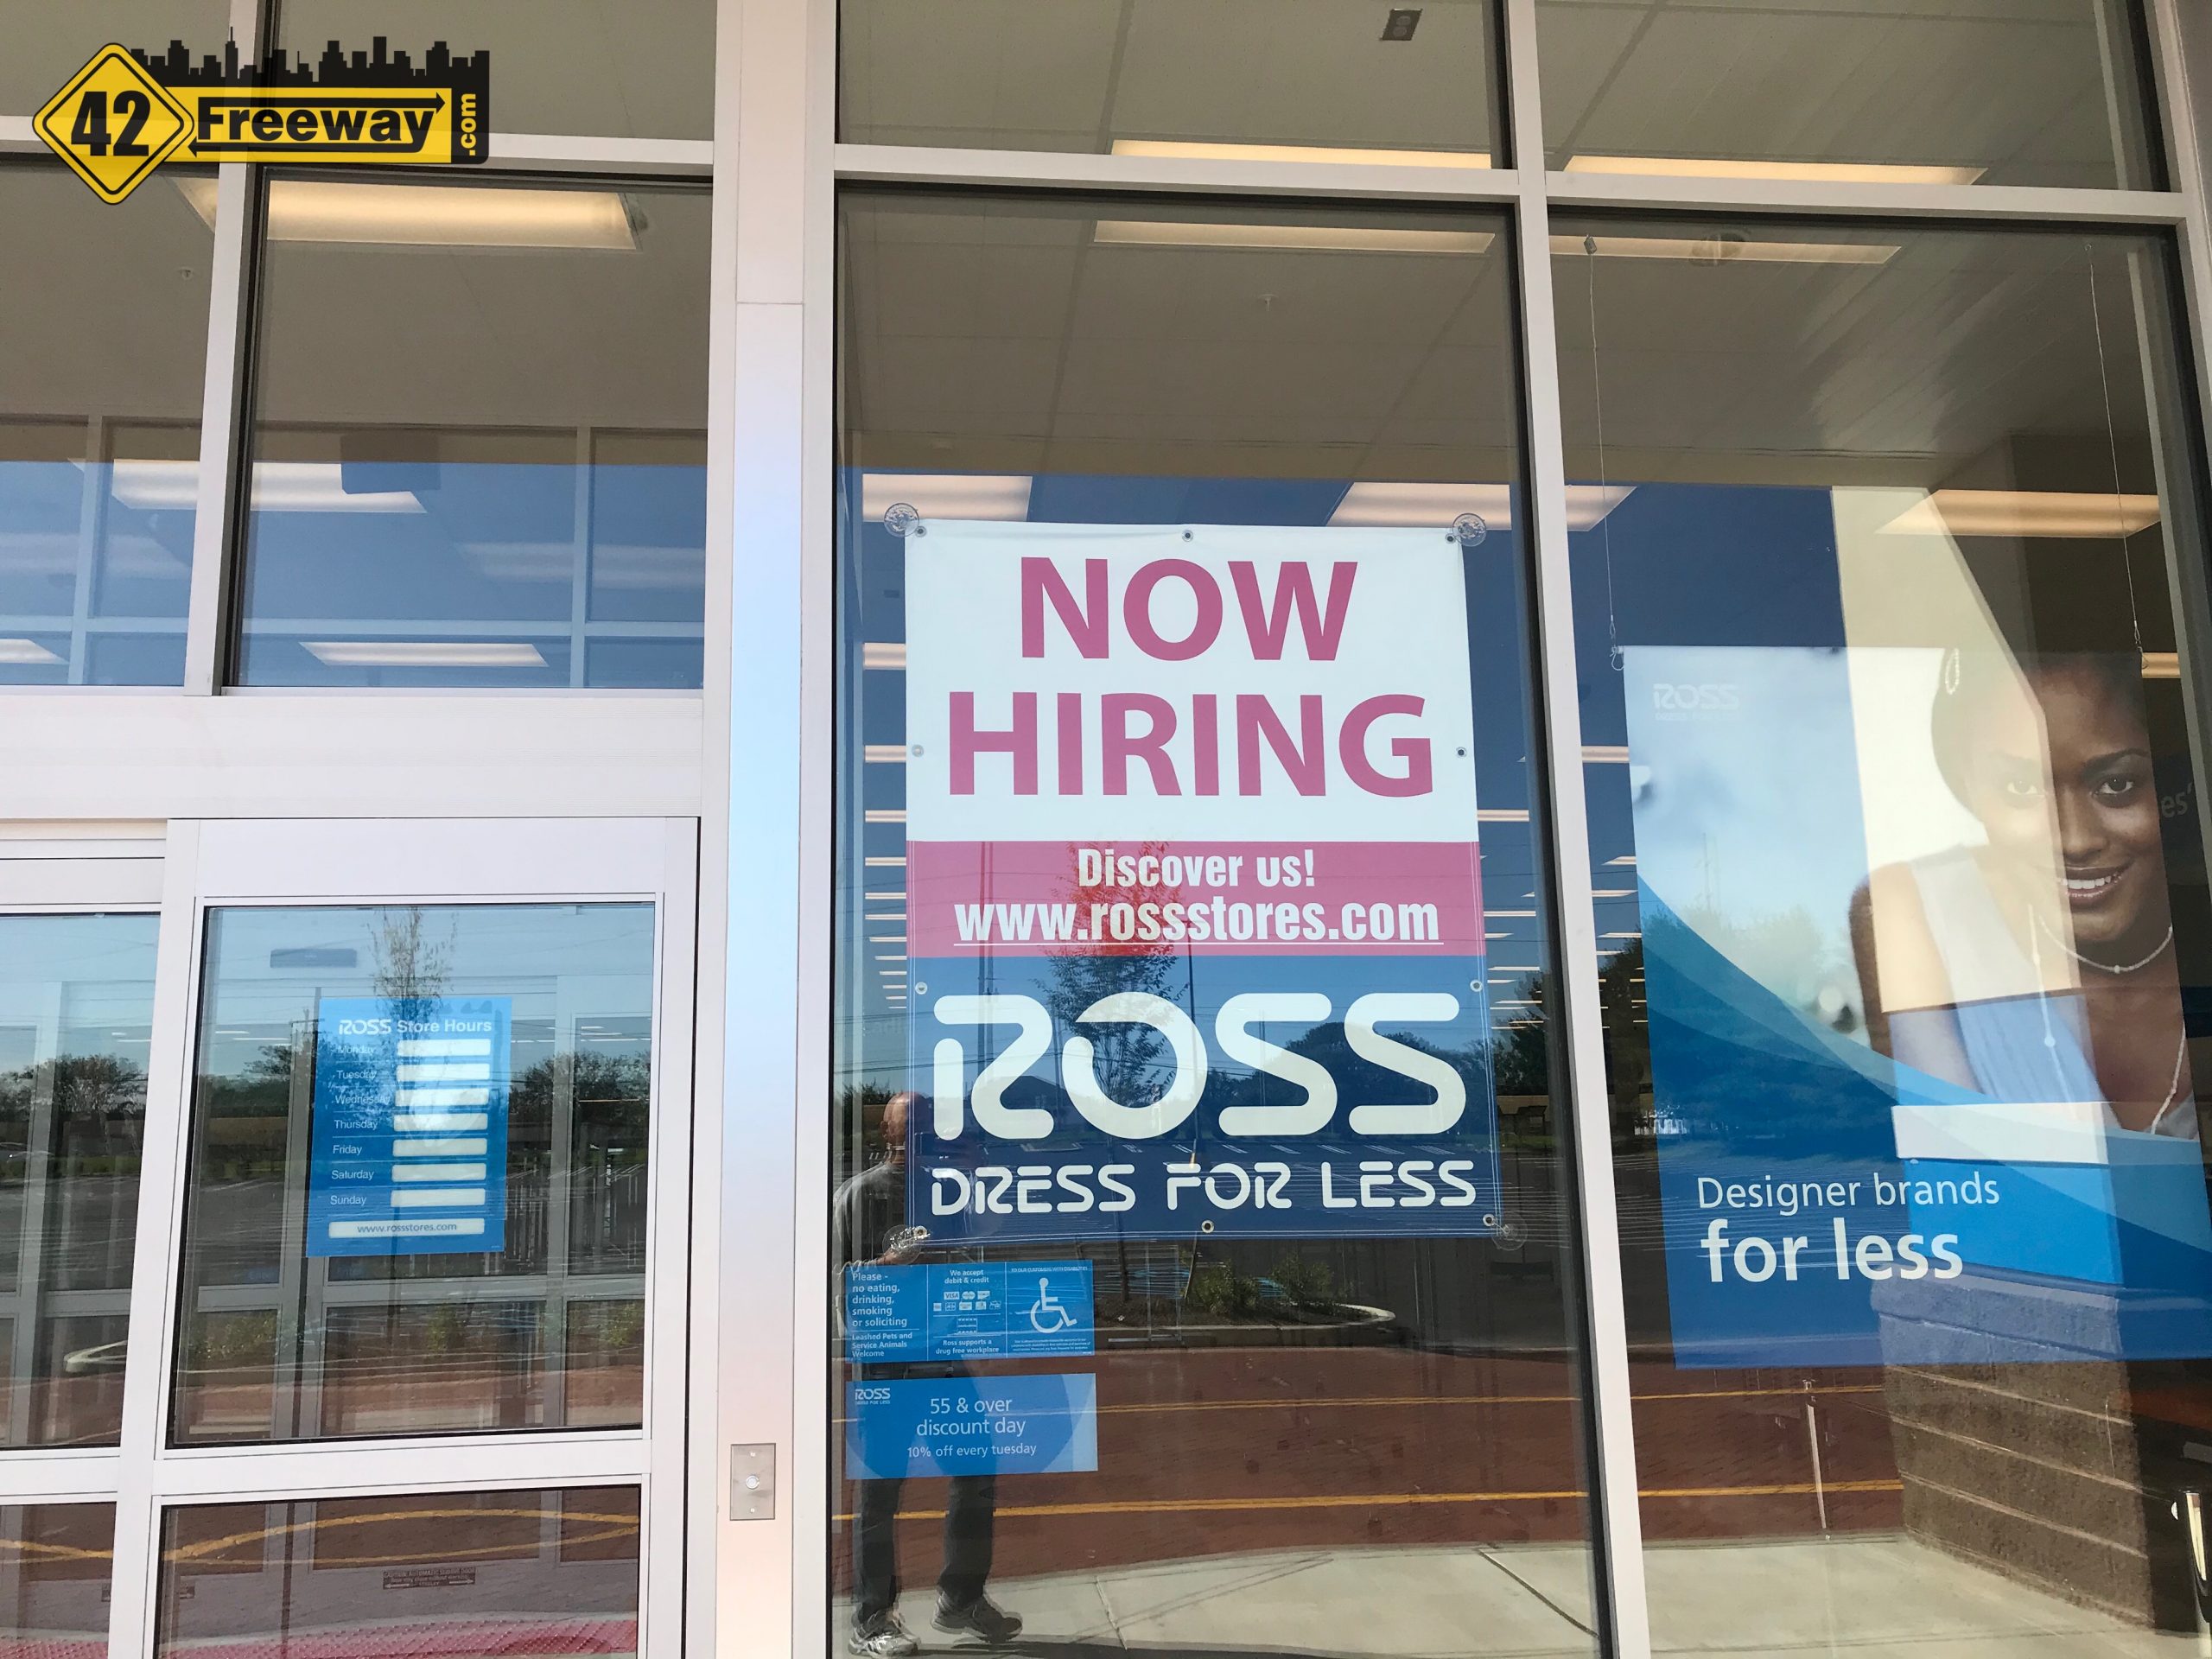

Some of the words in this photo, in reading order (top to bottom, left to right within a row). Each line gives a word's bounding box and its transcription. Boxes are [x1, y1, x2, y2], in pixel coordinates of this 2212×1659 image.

[1020, 556, 1357, 661] NOW
[1653, 683, 1739, 709] ROSS
[949, 691, 1433, 798] HIRING
[1077, 849, 1243, 887] Discover
[1256, 849, 1314, 887] us!
[955, 897, 1440, 942] www.rossstores.com
[339, 1020, 391, 1035] ROSS
[397, 1020, 440, 1033] Store
[444, 1019, 493, 1033] Hours
[933, 991, 1466, 1141] ROSS
[336, 1070, 377, 1082] Tuesday
[335, 1094, 391, 1106] Wednesday
[334, 1120, 378, 1130] Thursday
[333, 1145, 363, 1155] Friday
[331, 1170, 374, 1181] Saturday
[931, 1163, 1135, 1215] DRESS
[1166, 1162, 1291, 1210] FOR
[1322, 1160, 1476, 1207] LESS
[330, 1195, 367, 1206] Sunday
[1698, 1176, 1861, 1217] Designer
[1874, 1172, 2001, 1207] brands
[357, 1222, 458, 1234] www.rossstores.com
[1700, 1218, 1809, 1283] for
[1833, 1217, 1965, 1281] less
[852, 1273, 882, 1281] Please
[867, 1283, 900, 1294] eating,
[852, 1294, 894, 1306] drinking,
[852, 1306, 893, 1316] smoking
[865, 1318, 907, 1327] soliciting
[855, 1388, 891, 1400] ROSS
[930, 1398, 950, 1414] 55
[956, 1397, 969, 1414] &
[975, 1398, 1012, 1413] over
[916, 1419, 989, 1436] discount
[995, 1418, 1026, 1437] day
[907, 1446, 931, 1458] 10%
[936, 1445, 953, 1457] off
[957, 1446, 988, 1458] every
[991, 1443, 1037, 1456] tuesday
